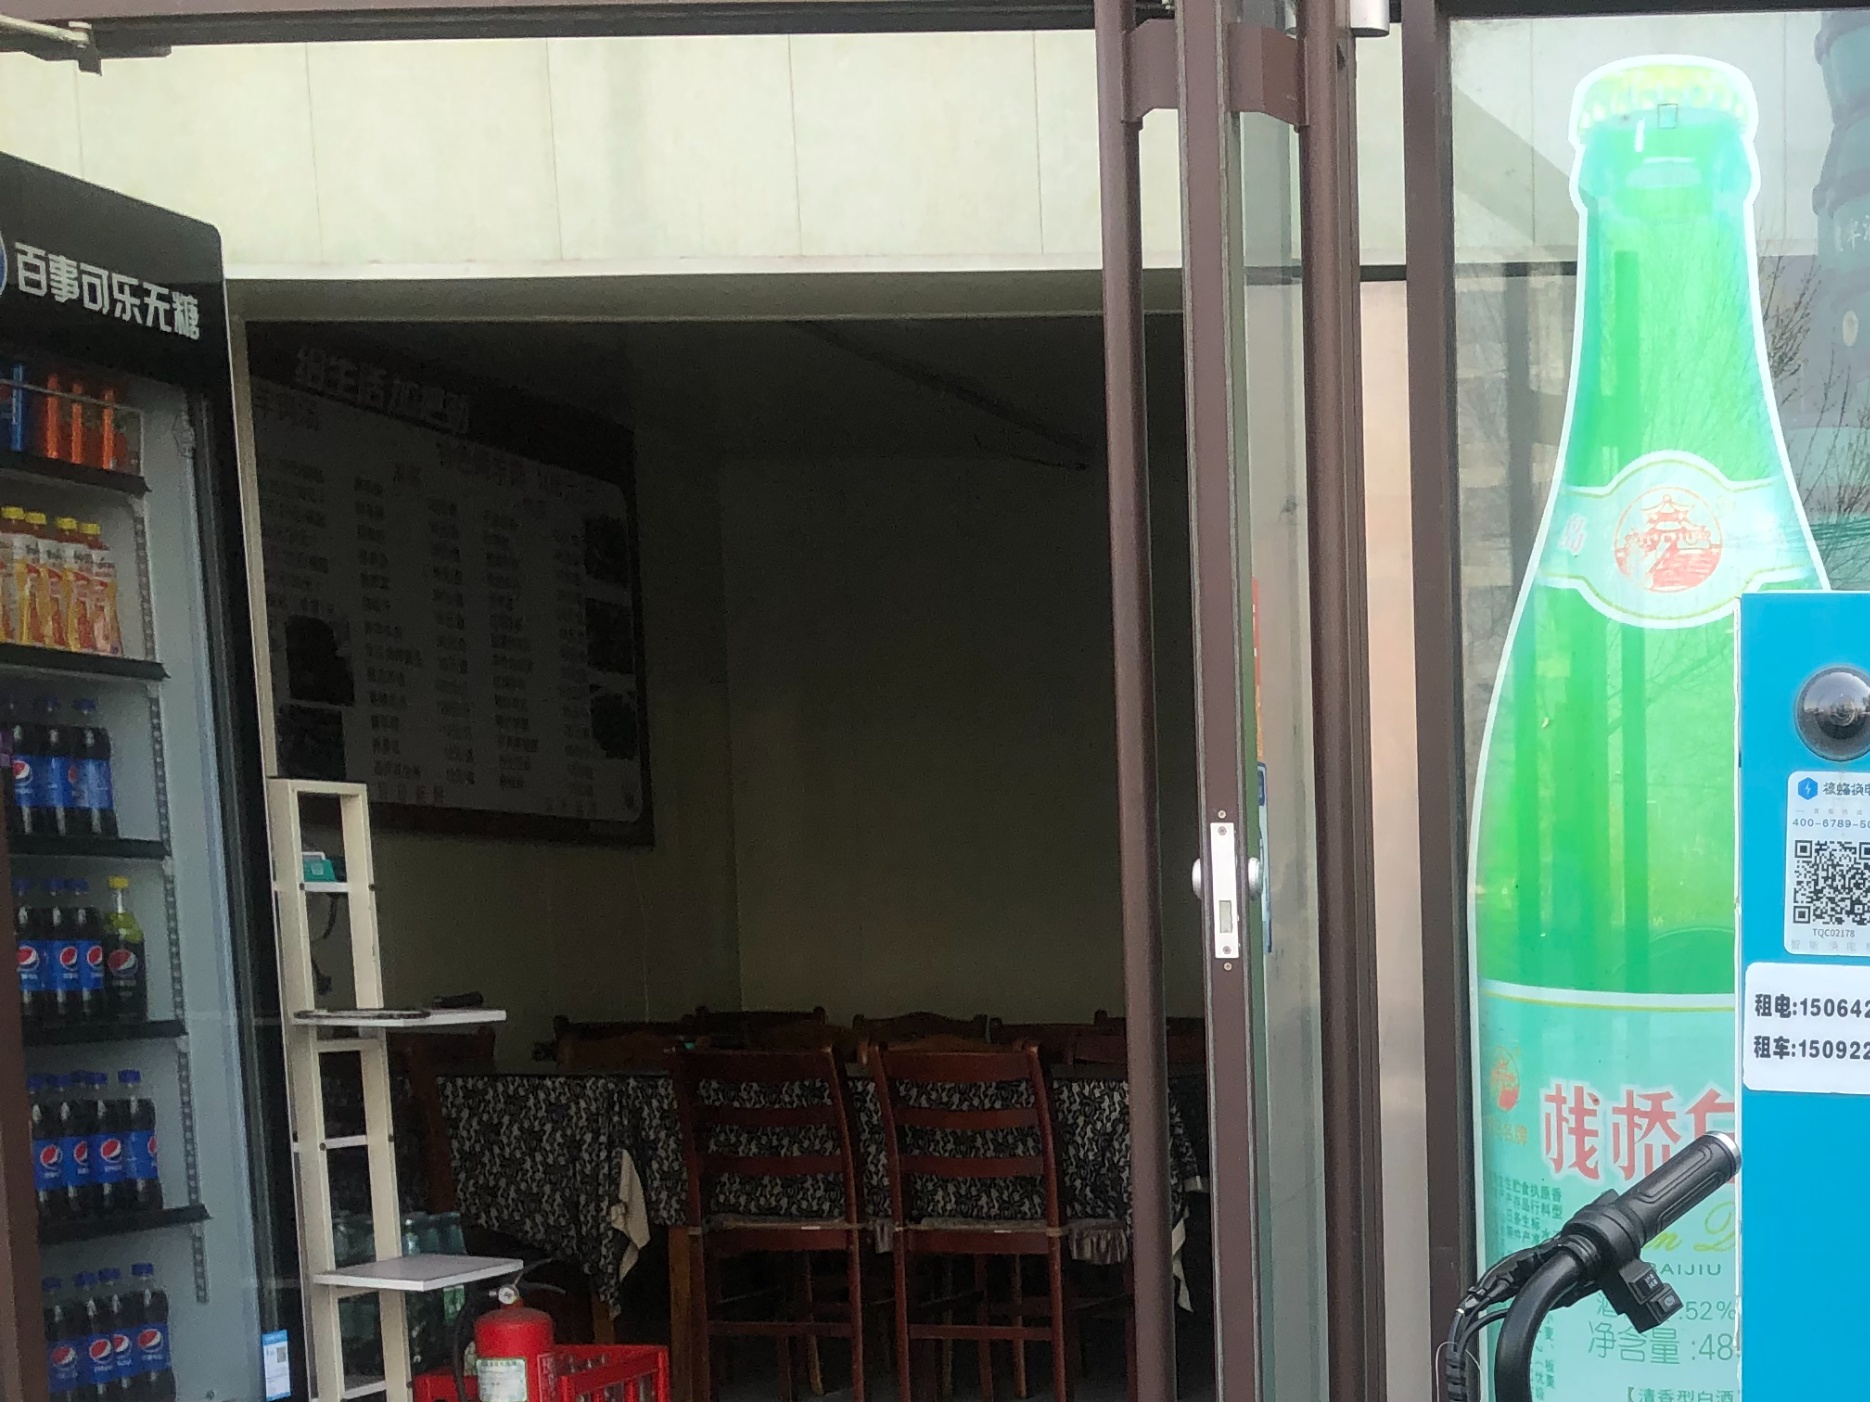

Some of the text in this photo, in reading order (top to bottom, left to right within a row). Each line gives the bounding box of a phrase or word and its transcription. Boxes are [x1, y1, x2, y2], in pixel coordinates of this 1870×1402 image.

[15, 241, 200, 340] 百事可乐无糖
[1812, 928, 1856, 938] TQC02178
